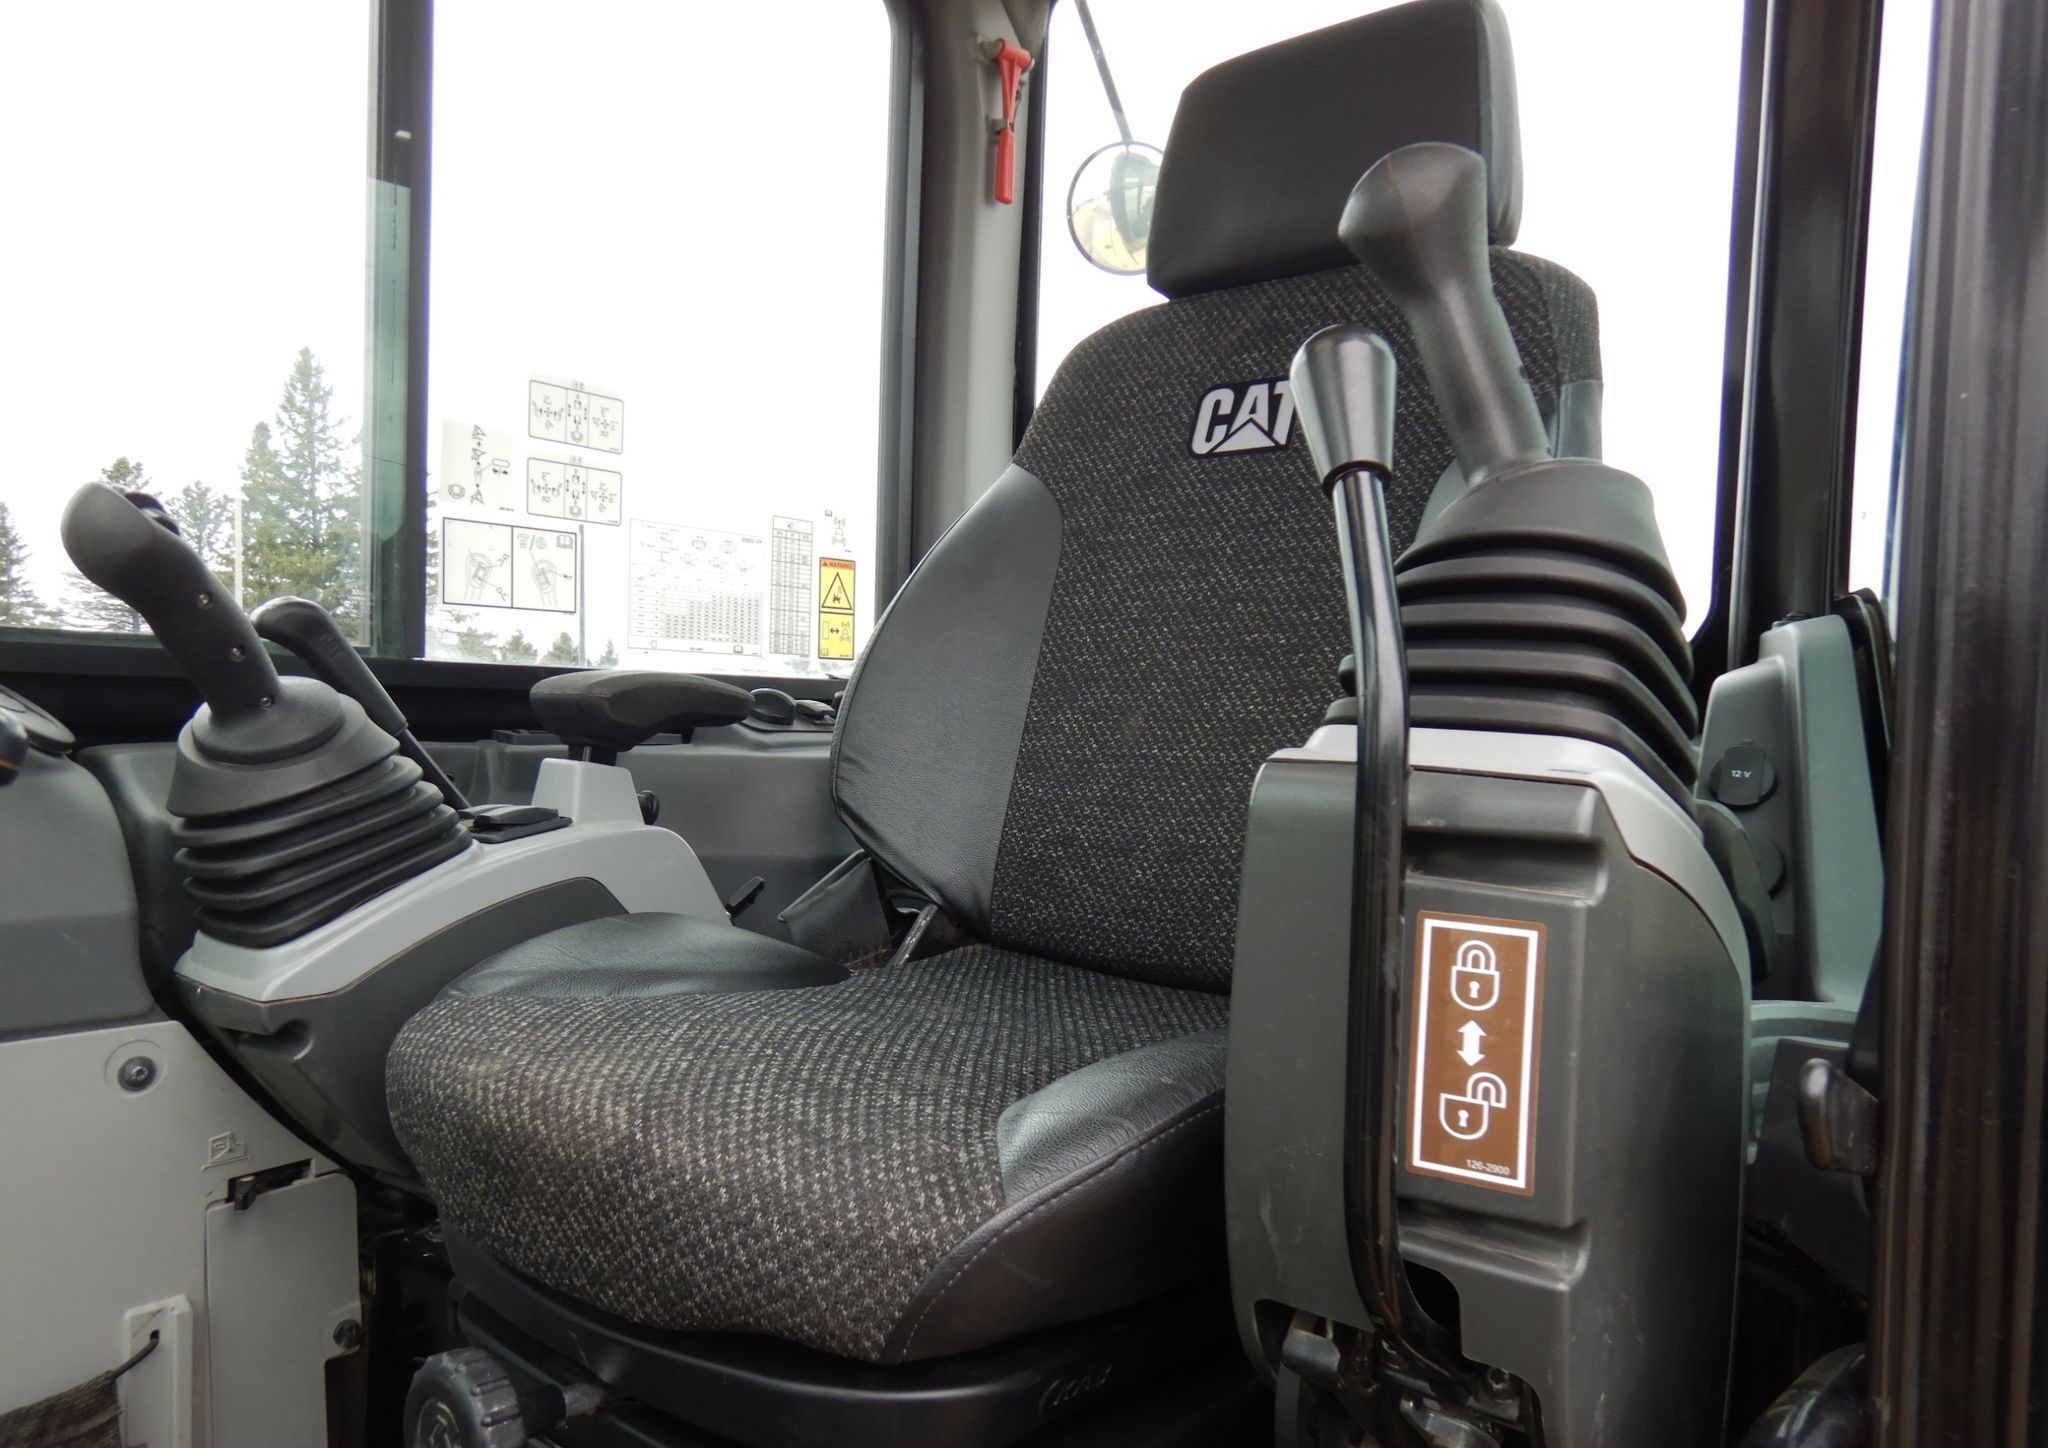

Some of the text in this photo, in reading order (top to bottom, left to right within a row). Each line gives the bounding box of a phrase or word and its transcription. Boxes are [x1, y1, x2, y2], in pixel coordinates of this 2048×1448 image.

[828, 561, 853, 570] WARNING
[1731, 770, 1752, 778] 12 V
